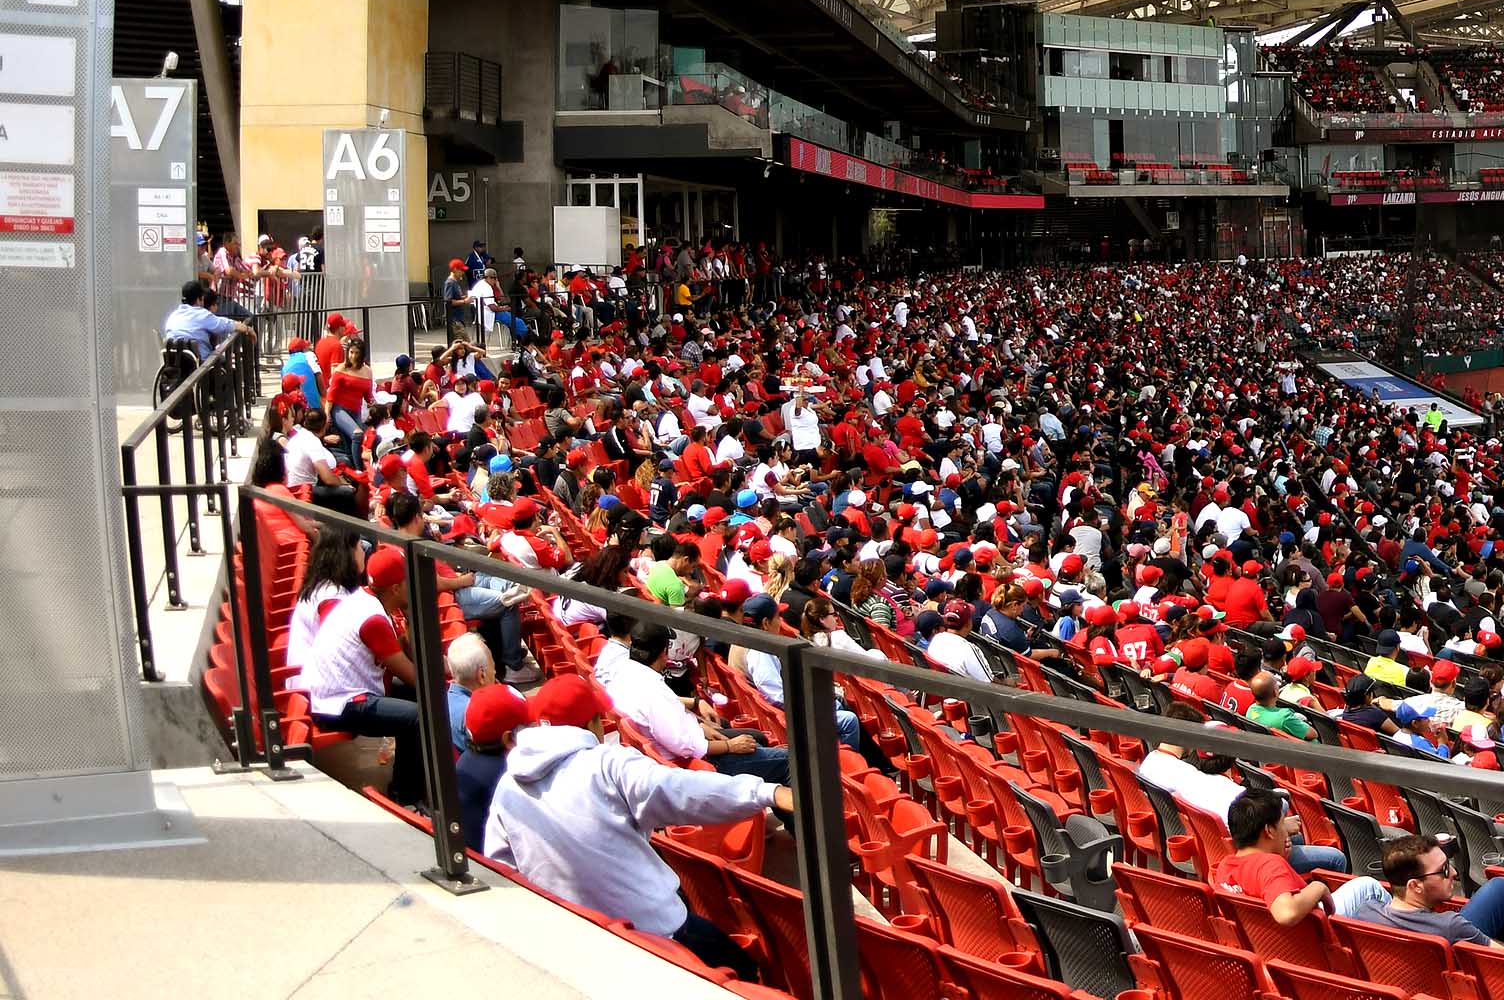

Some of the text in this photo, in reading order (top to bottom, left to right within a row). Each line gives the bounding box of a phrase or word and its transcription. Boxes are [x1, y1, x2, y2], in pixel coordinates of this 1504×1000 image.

[111, 85, 186, 150] A7
[1432, 130, 1476, 139] ESTADIO
[326, 133, 400, 181] A6
[428, 172, 471, 202] A5
[1457, 190, 1480, 201] JESÚS
[300, 253, 315, 270] 24
[1123, 641, 1148, 660] 97
